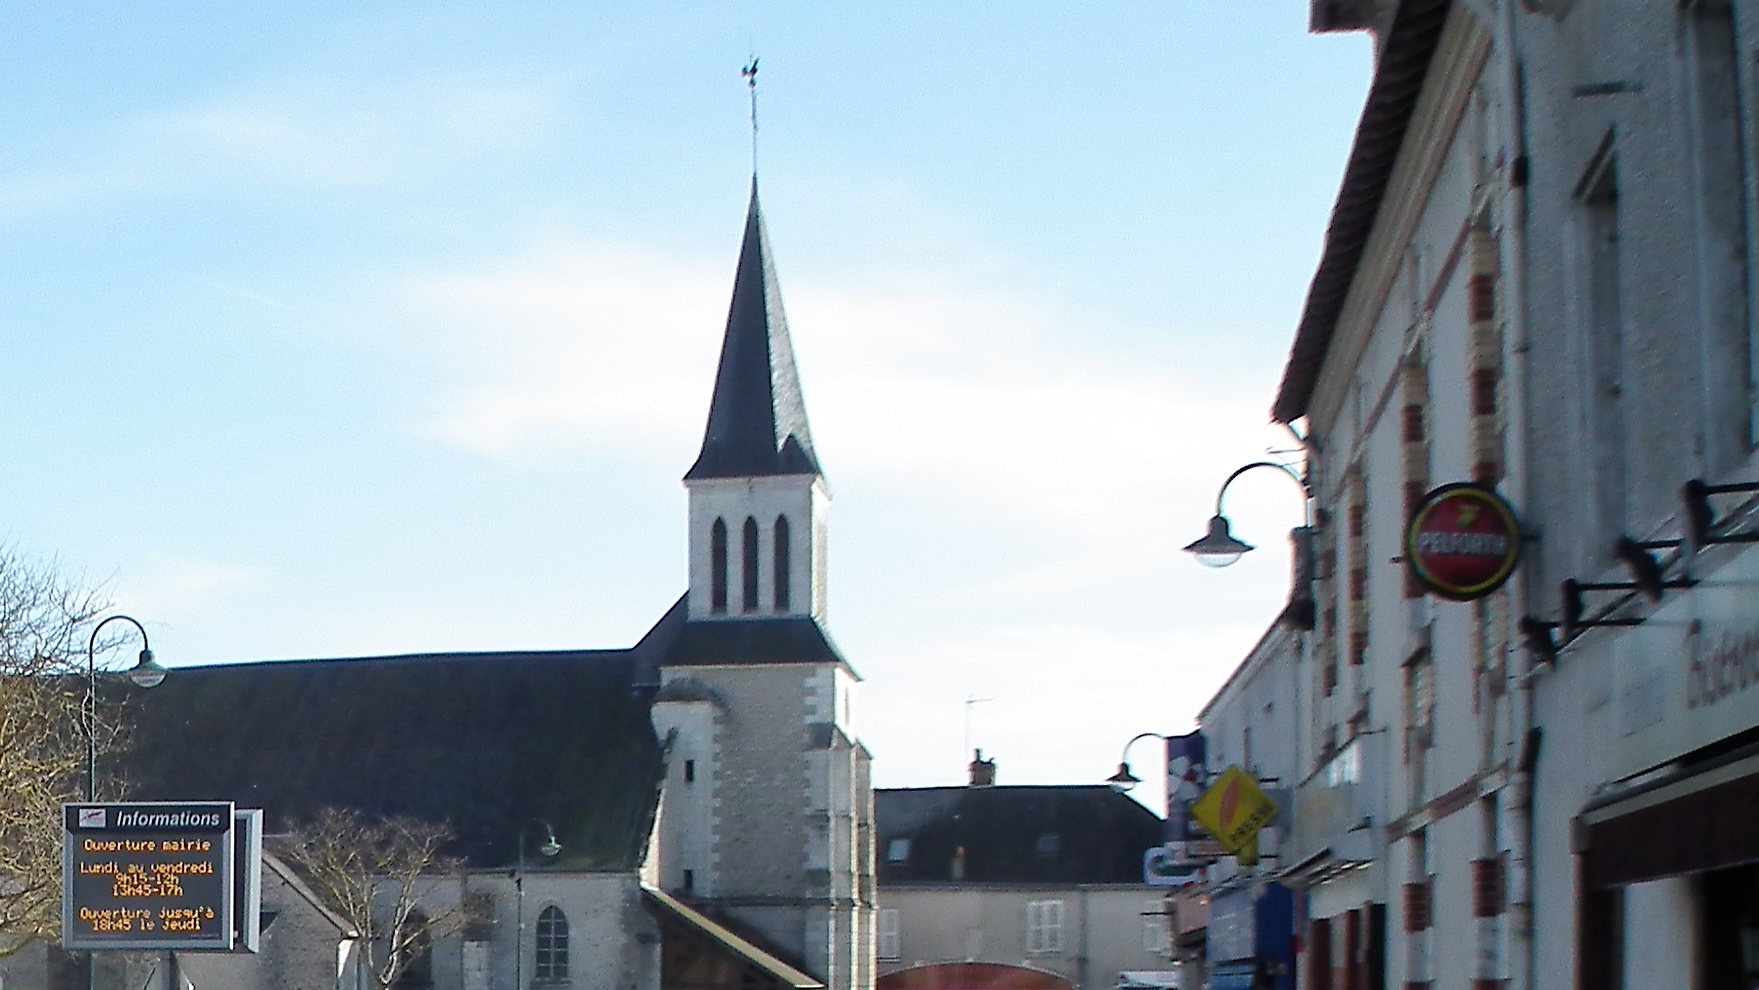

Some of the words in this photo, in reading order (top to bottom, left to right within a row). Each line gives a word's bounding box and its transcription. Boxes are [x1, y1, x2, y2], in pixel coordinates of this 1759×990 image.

[116, 810, 221, 828] Informations
[84, 839, 156, 851] Ouverture
[162, 839, 211, 851] mairie
[80, 861, 119, 874] Lundi
[127, 864, 143, 874] au
[150, 861, 214, 874] vendredi
[115, 873, 180, 885] 9h15-12h
[112, 884, 184, 896] 13h45-17h
[80, 907, 151, 919] Ouverture
[92, 918, 132, 931] 18h45
[140, 918, 155, 931] le
[161, 918, 202, 931] jeudi
